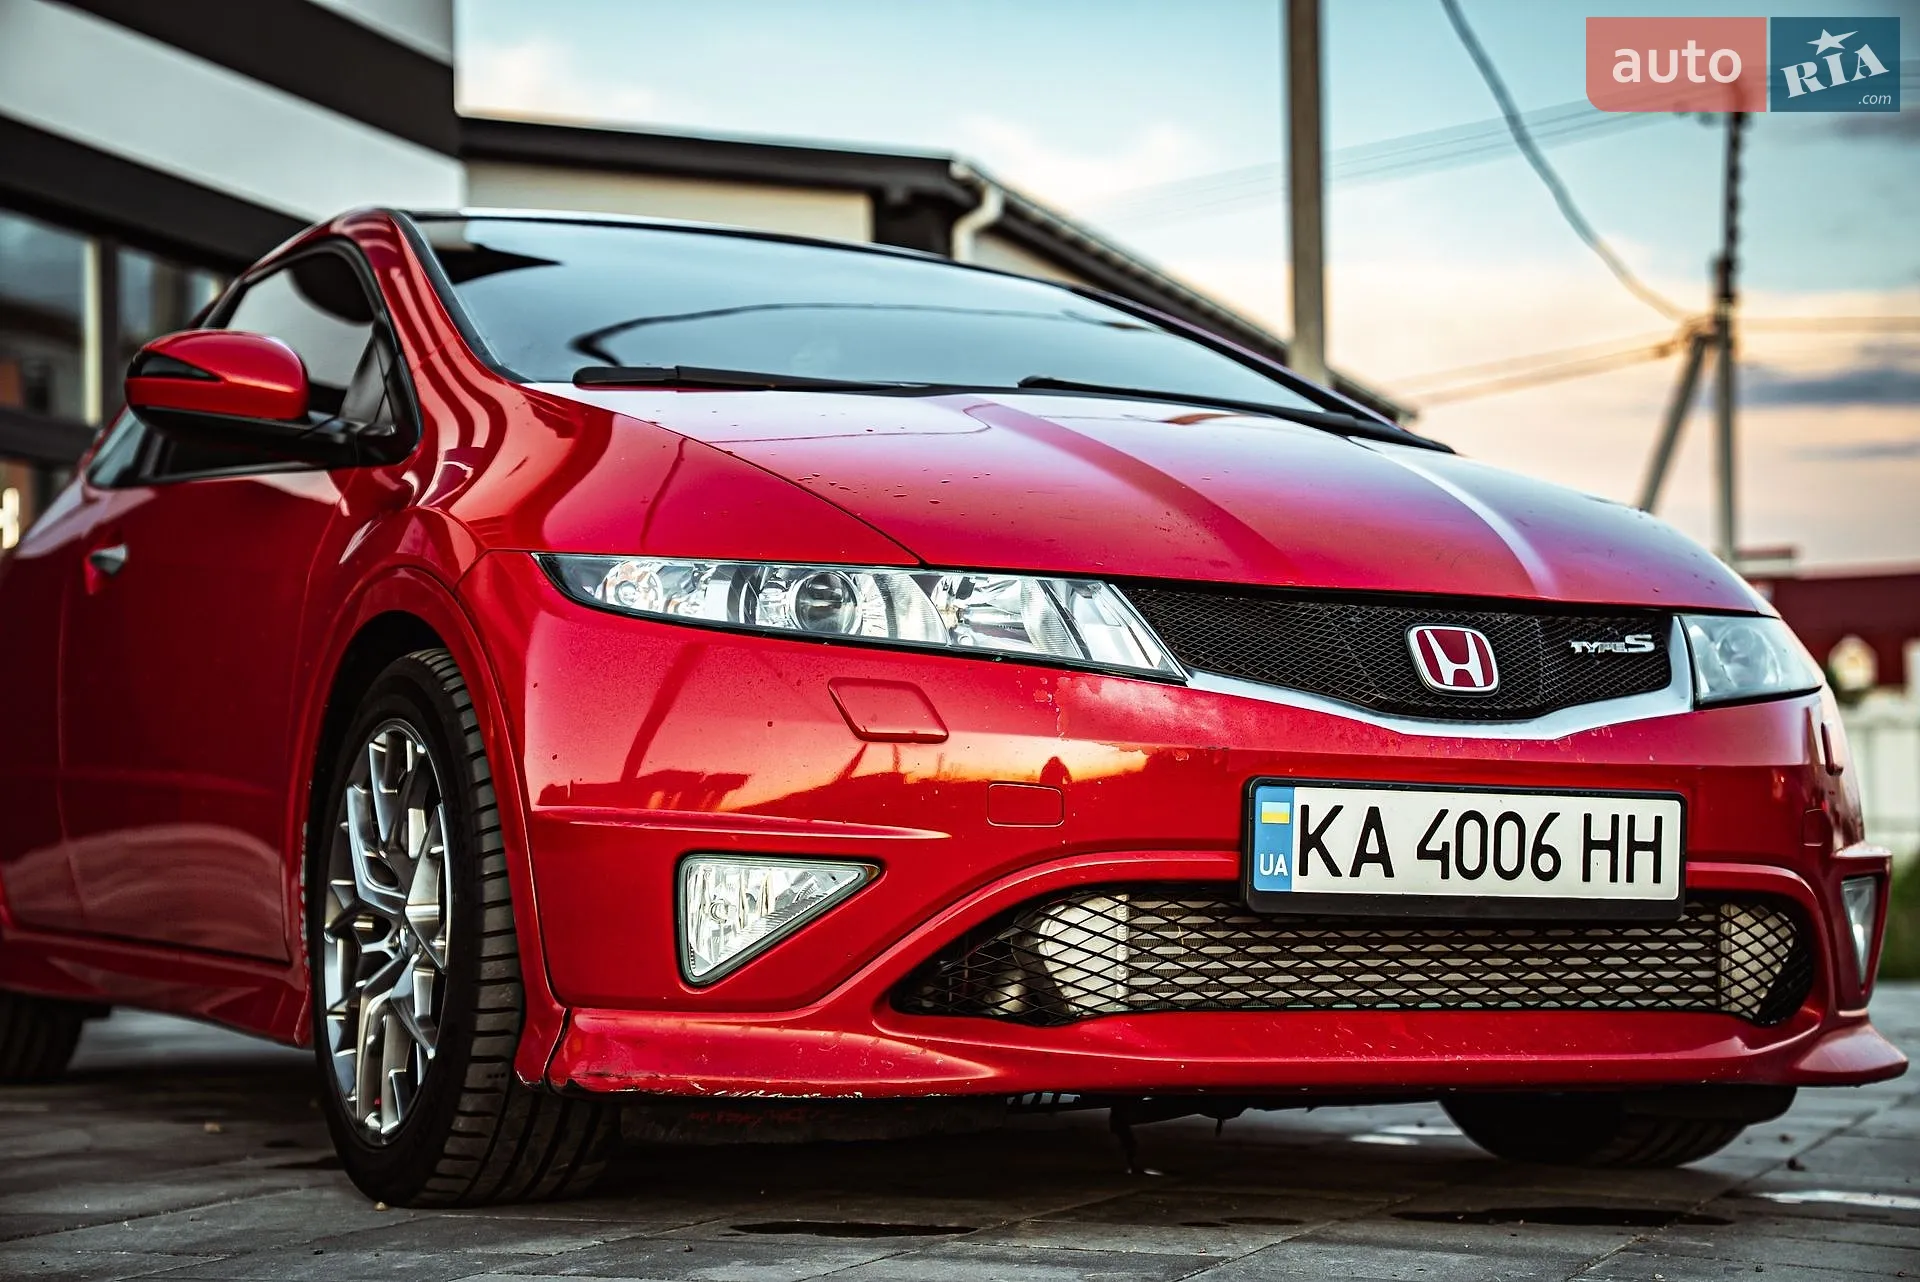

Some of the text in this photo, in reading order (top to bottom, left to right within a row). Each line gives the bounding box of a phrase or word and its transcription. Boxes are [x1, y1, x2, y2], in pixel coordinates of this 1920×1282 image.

[1259, 854, 1288, 876] UA
[1298, 804, 1663, 884] KA 4006 HH
